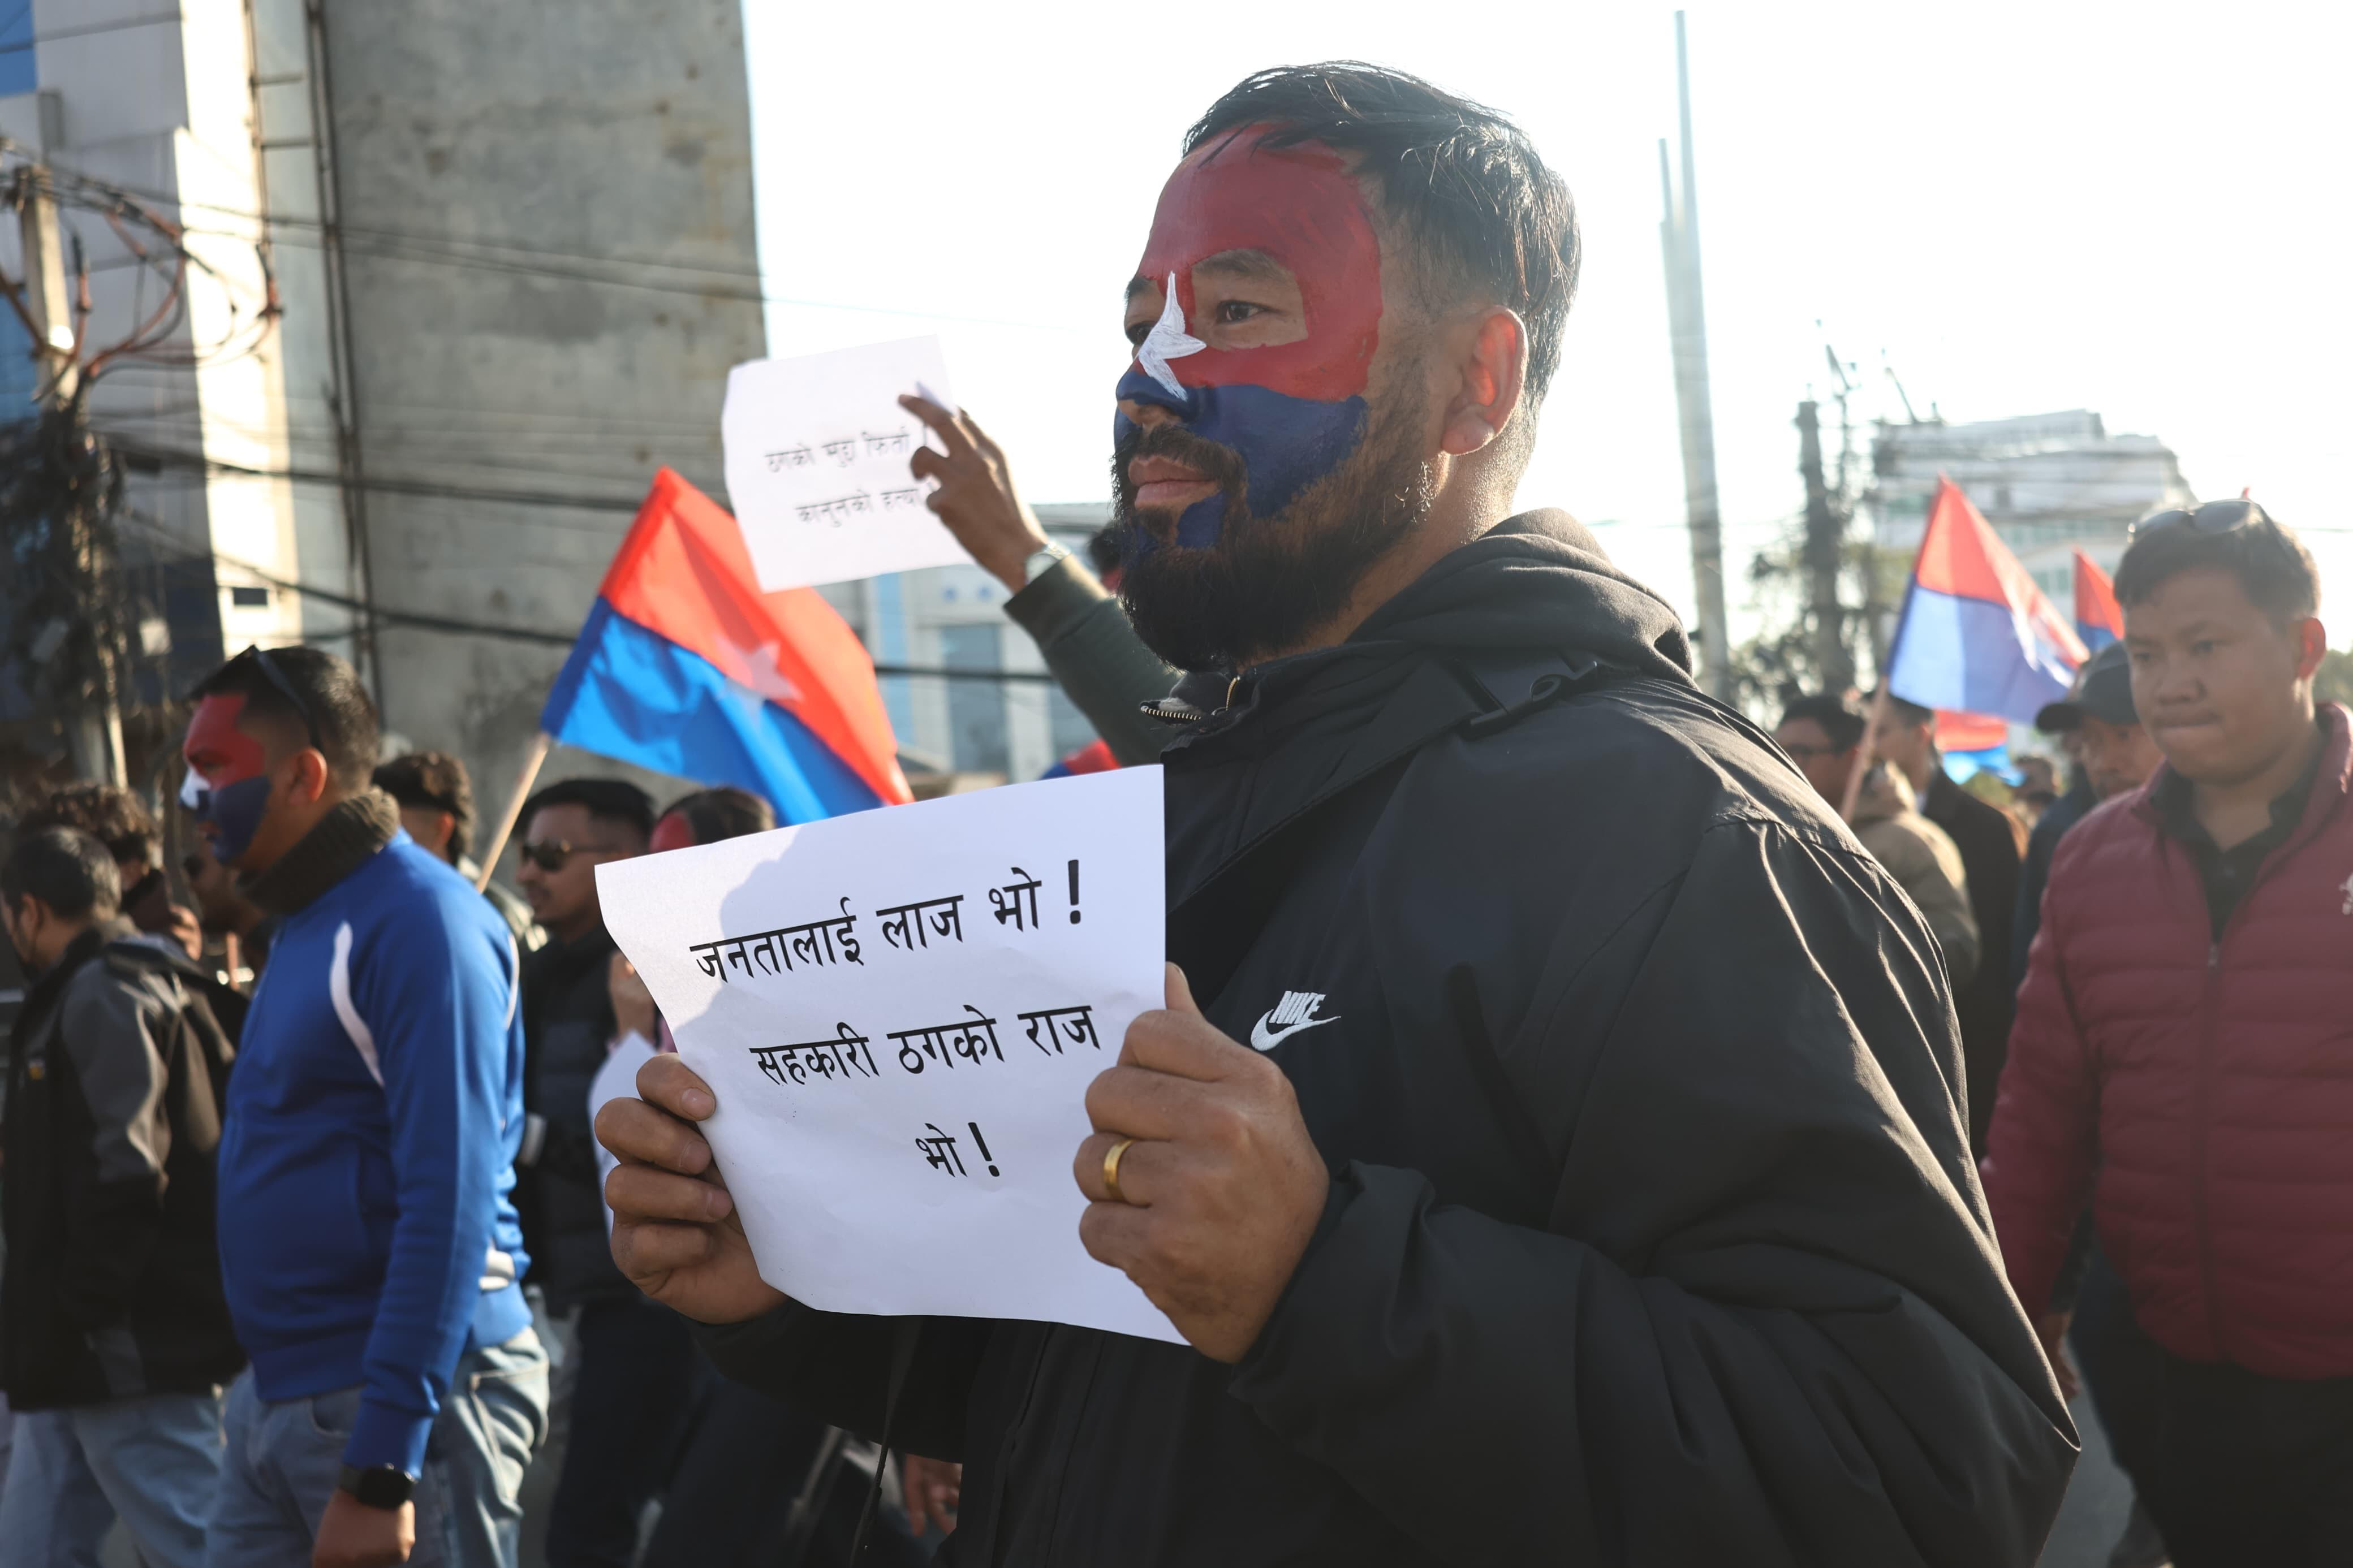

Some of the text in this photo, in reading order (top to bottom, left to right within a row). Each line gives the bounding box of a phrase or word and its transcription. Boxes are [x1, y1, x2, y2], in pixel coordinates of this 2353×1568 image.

[689, 859, 1081, 983] जनतालाई लाज भो !
[749, 1004, 1101, 1085] सहकारी ठगको राज
[1269, 991, 1326, 1024] NIKE
